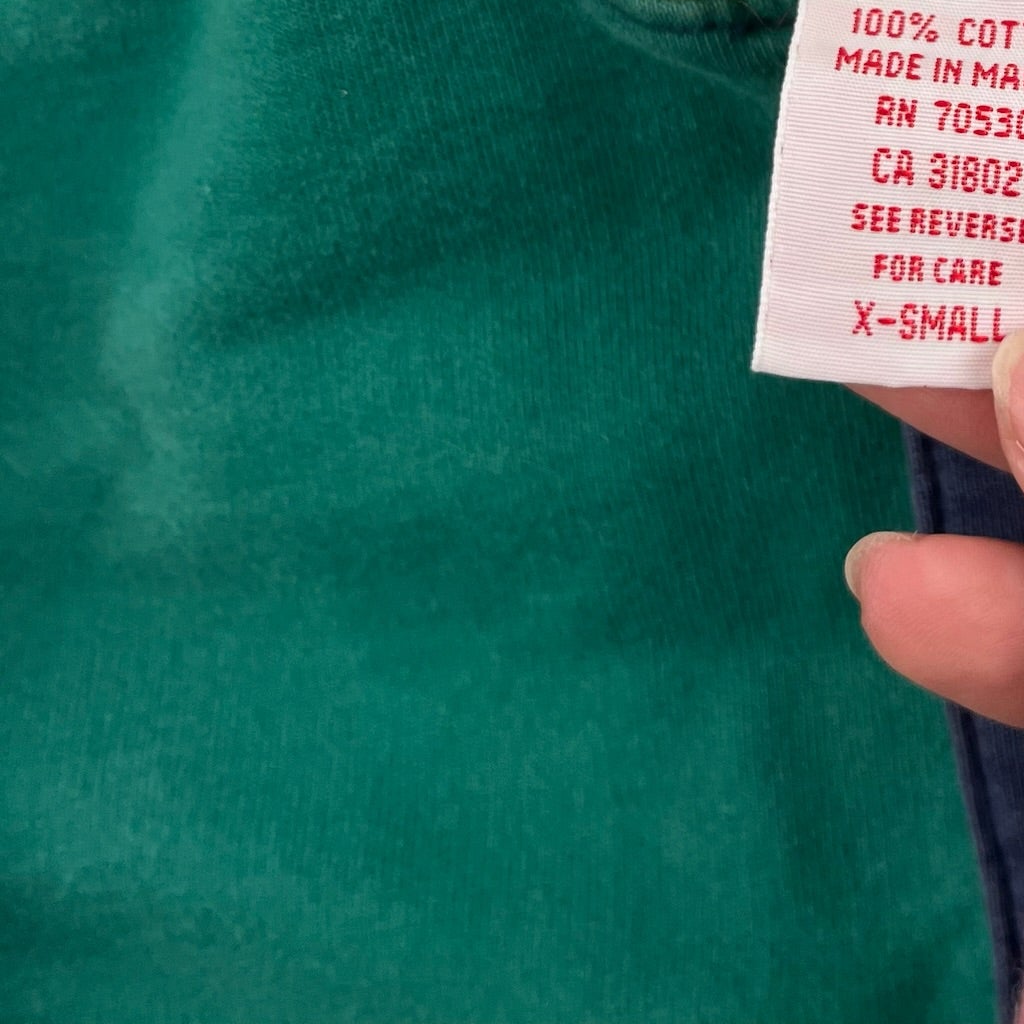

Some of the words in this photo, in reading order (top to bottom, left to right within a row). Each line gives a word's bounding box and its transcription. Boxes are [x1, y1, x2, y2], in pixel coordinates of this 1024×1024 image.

[851, 7, 939, 43] 100%
[834, 46, 922, 80] MADE
[933, 58, 962, 85] IN
[874, 96, 918, 128] RN
[872, 148, 915, 186] CA
[928, 153, 1024, 197] 31802
[850, 203, 901, 233] SEE
[872, 254, 924, 282] FOR
[933, 257, 1004, 286] CARE
[852, 300, 1006, 343] X-SMALL
